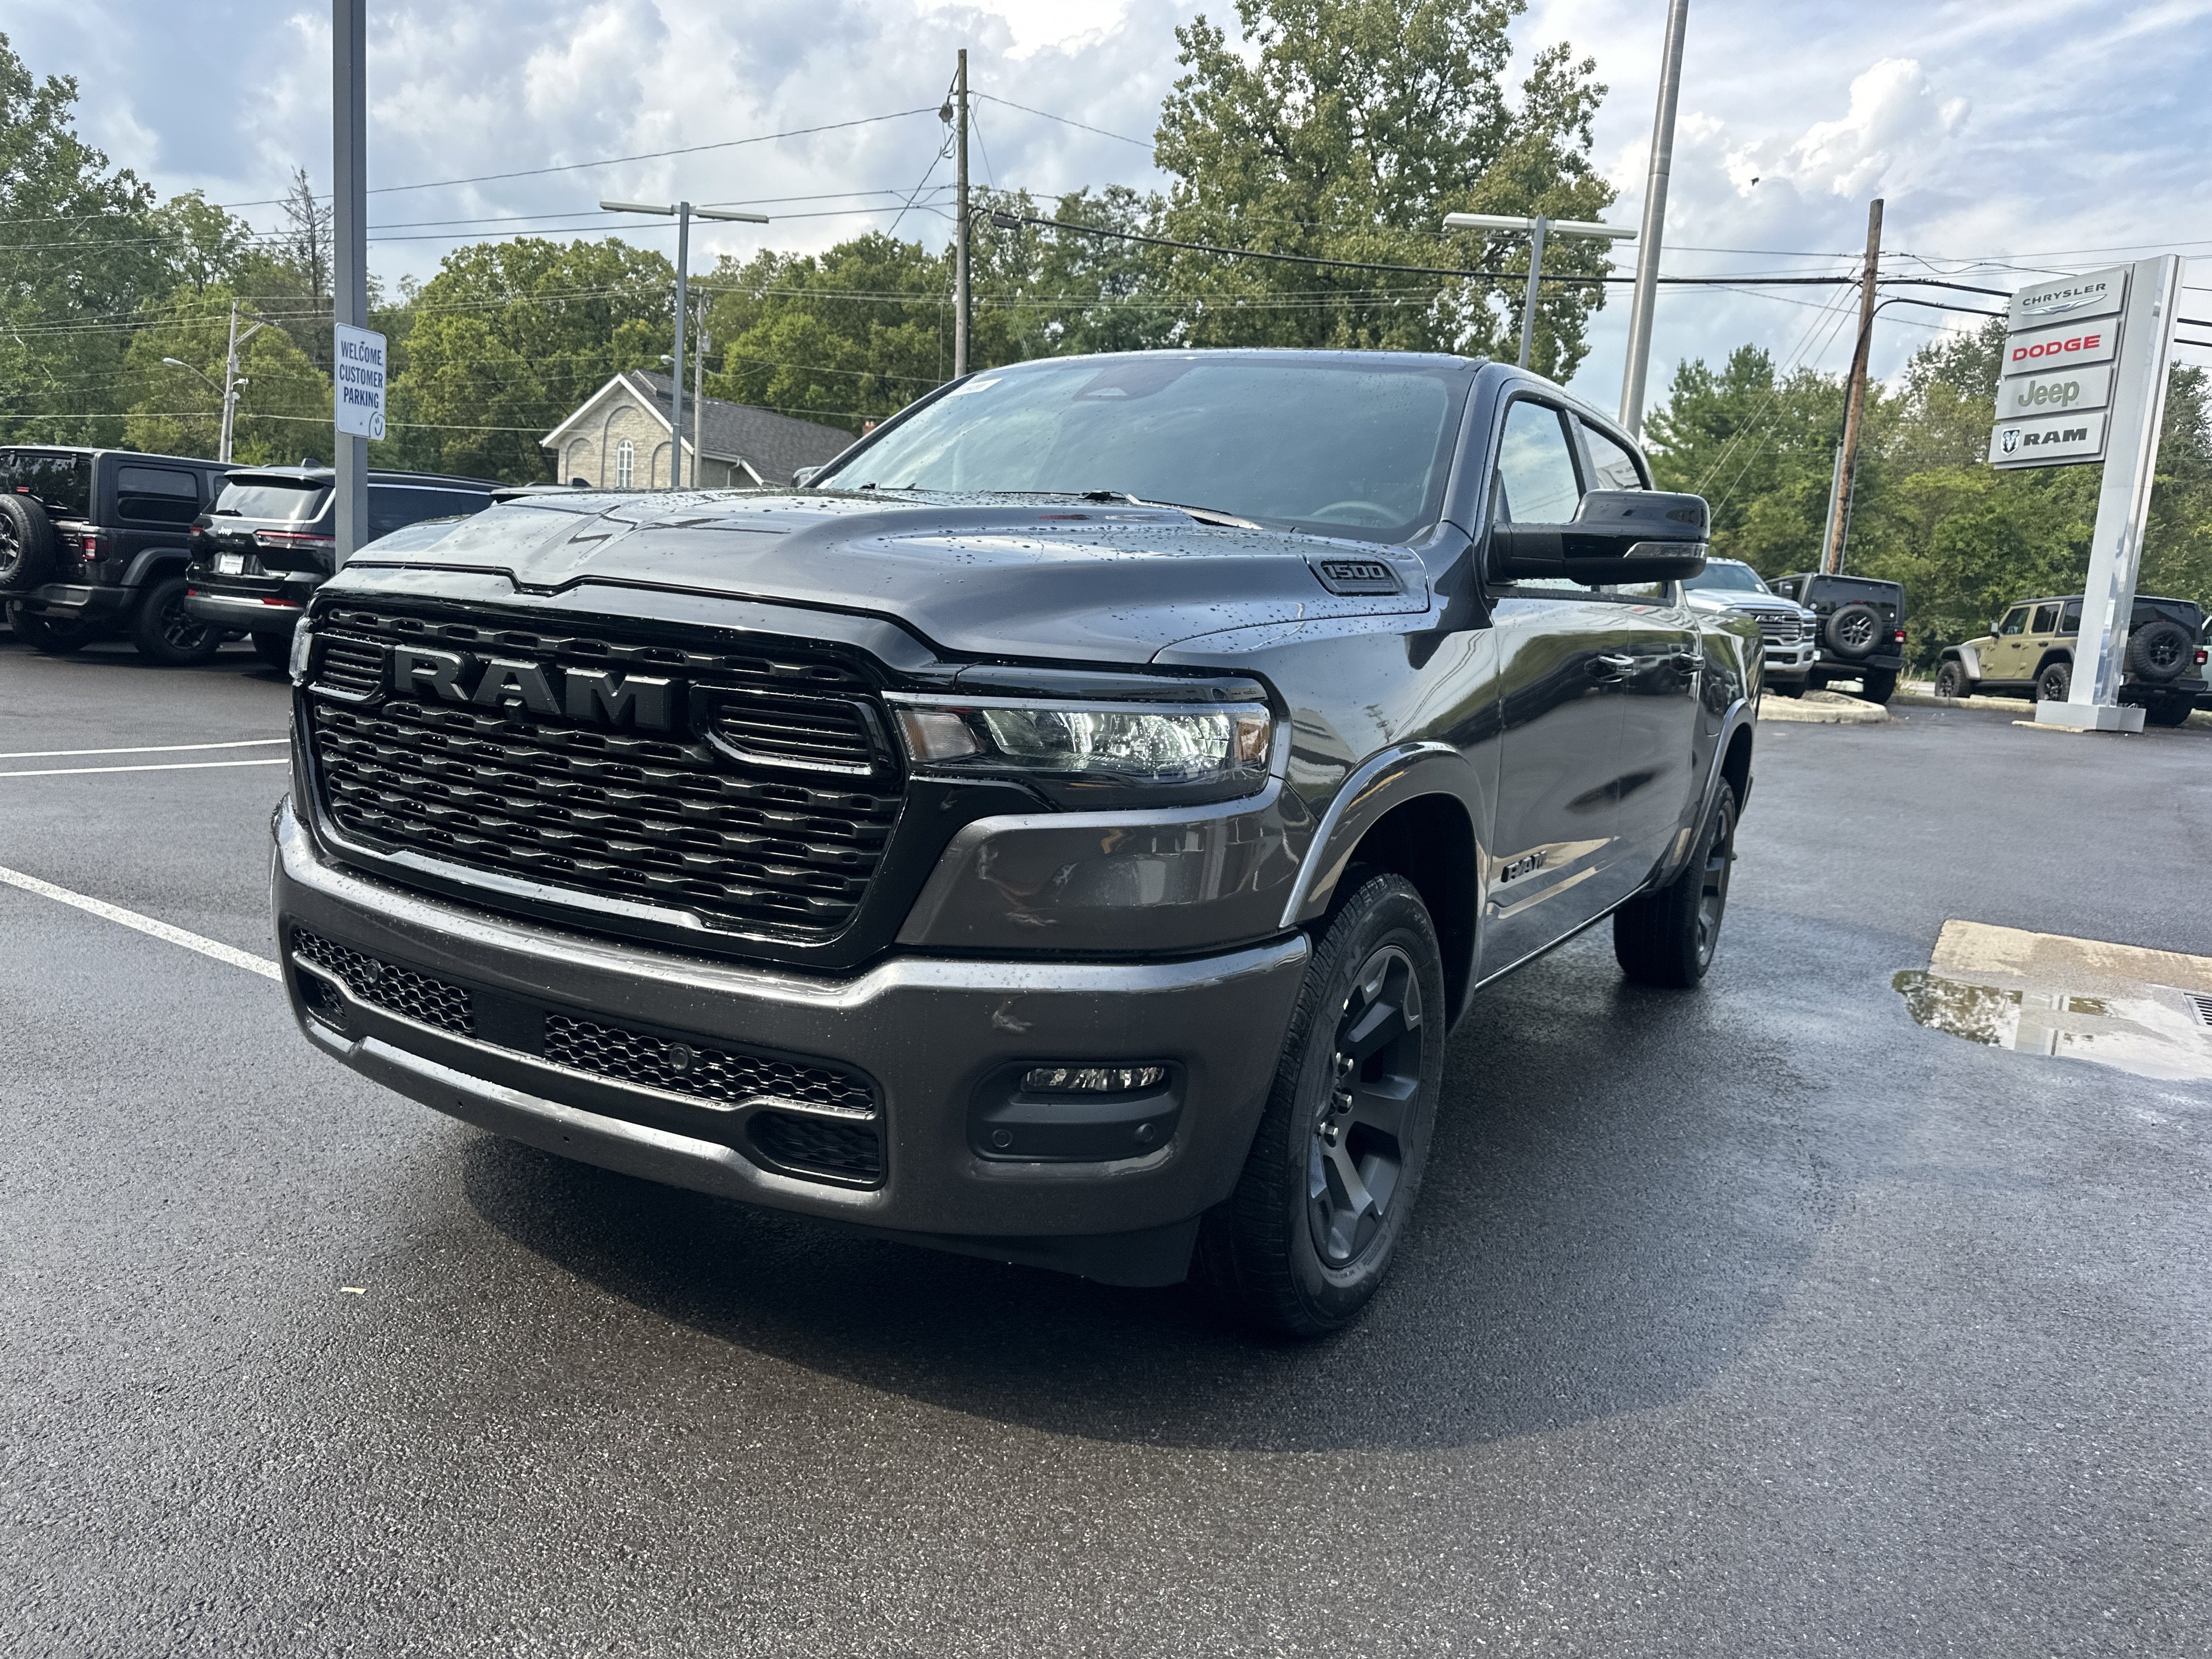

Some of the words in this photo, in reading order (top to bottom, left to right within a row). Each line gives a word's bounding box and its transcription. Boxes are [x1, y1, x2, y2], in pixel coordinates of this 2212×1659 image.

[2022, 283, 2107, 306] CHRYSLER
[341, 340, 382, 365] WELCOME
[2012, 335, 2101, 361] DODGE
[340, 364, 383, 388] CUSTOMER
[343, 387, 379, 408] PARKING
[2018, 380, 2080, 407] Jeep
[2023, 428, 2087, 446] RAM
[1322, 565, 1385, 578] 1500
[394, 645, 670, 731] RAM
